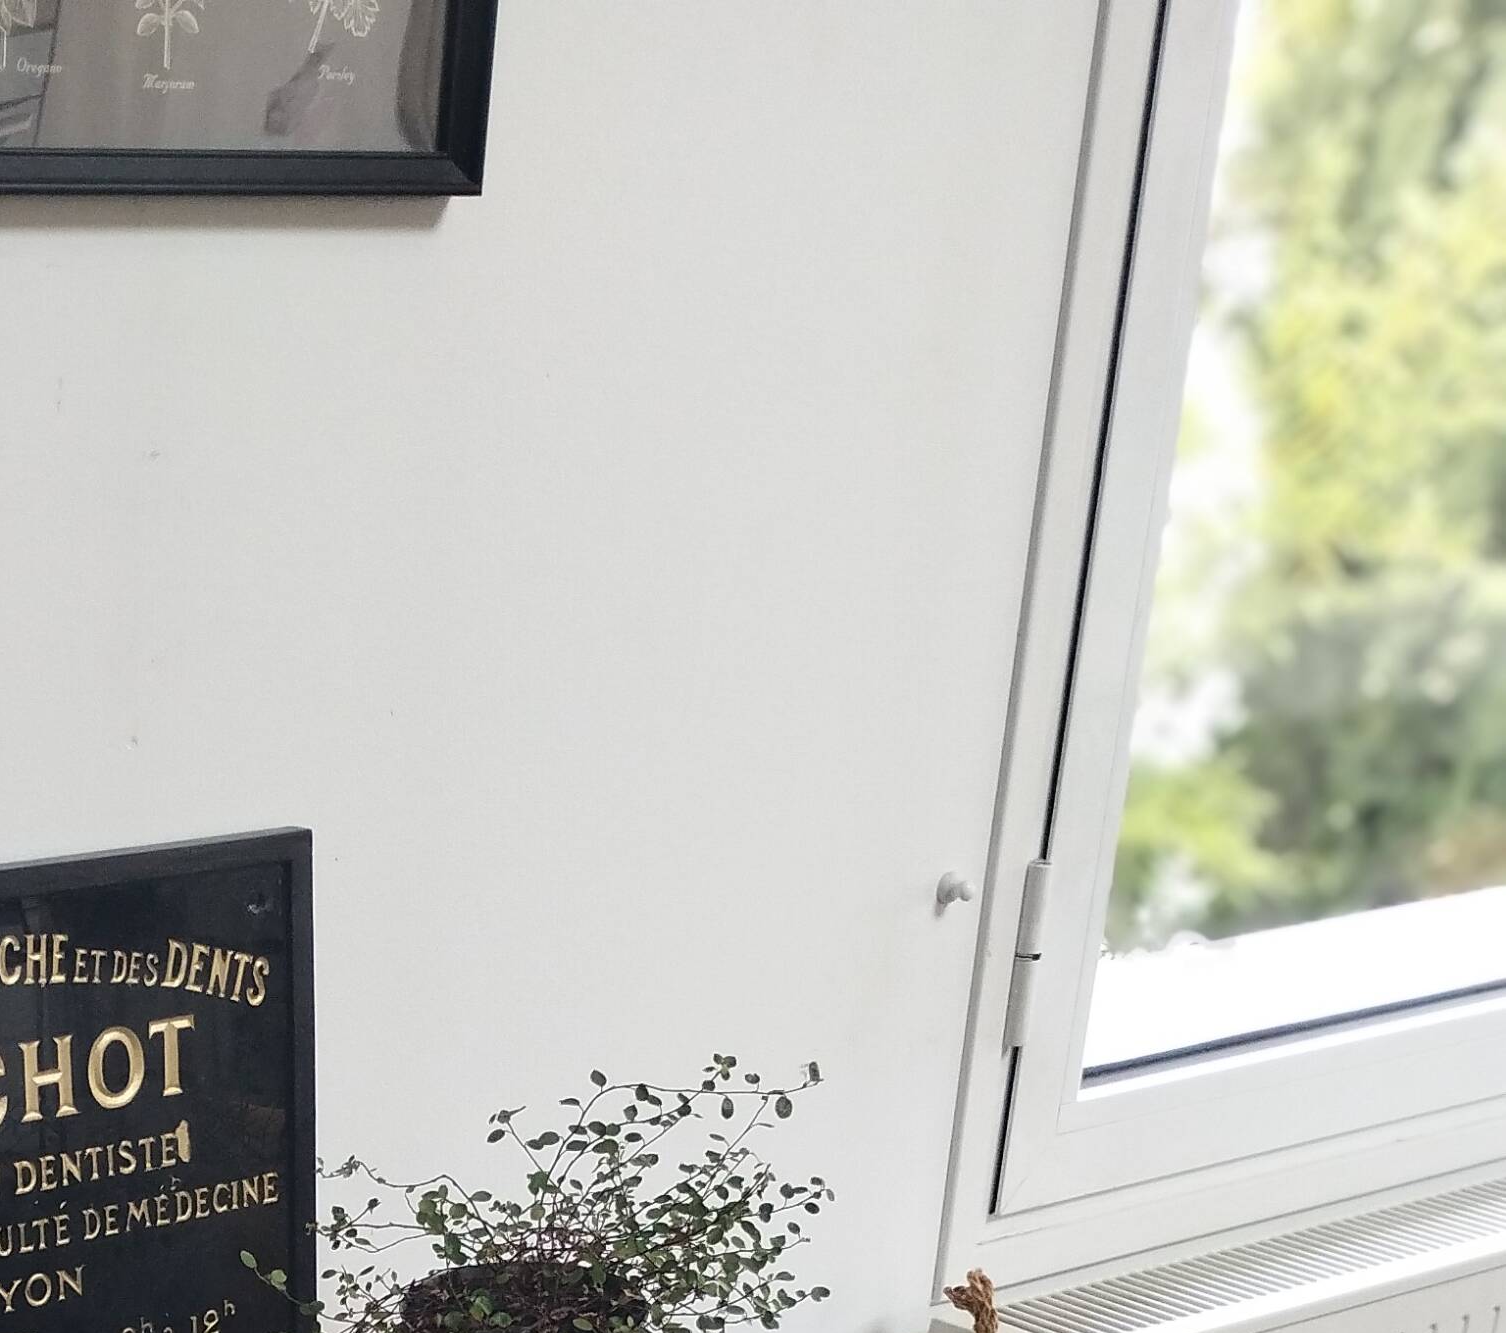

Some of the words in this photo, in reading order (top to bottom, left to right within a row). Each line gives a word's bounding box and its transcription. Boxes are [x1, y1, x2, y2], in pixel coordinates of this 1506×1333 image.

[17, 57, 62, 78] Oregano
[75, 948, 106, 984] ET
[110, 950, 159, 987] DES
[160, 937, 271, 1007] DENTS
[13, 1131, 180, 1196] DENTISTE
[81, 1204, 121, 1242] DE
